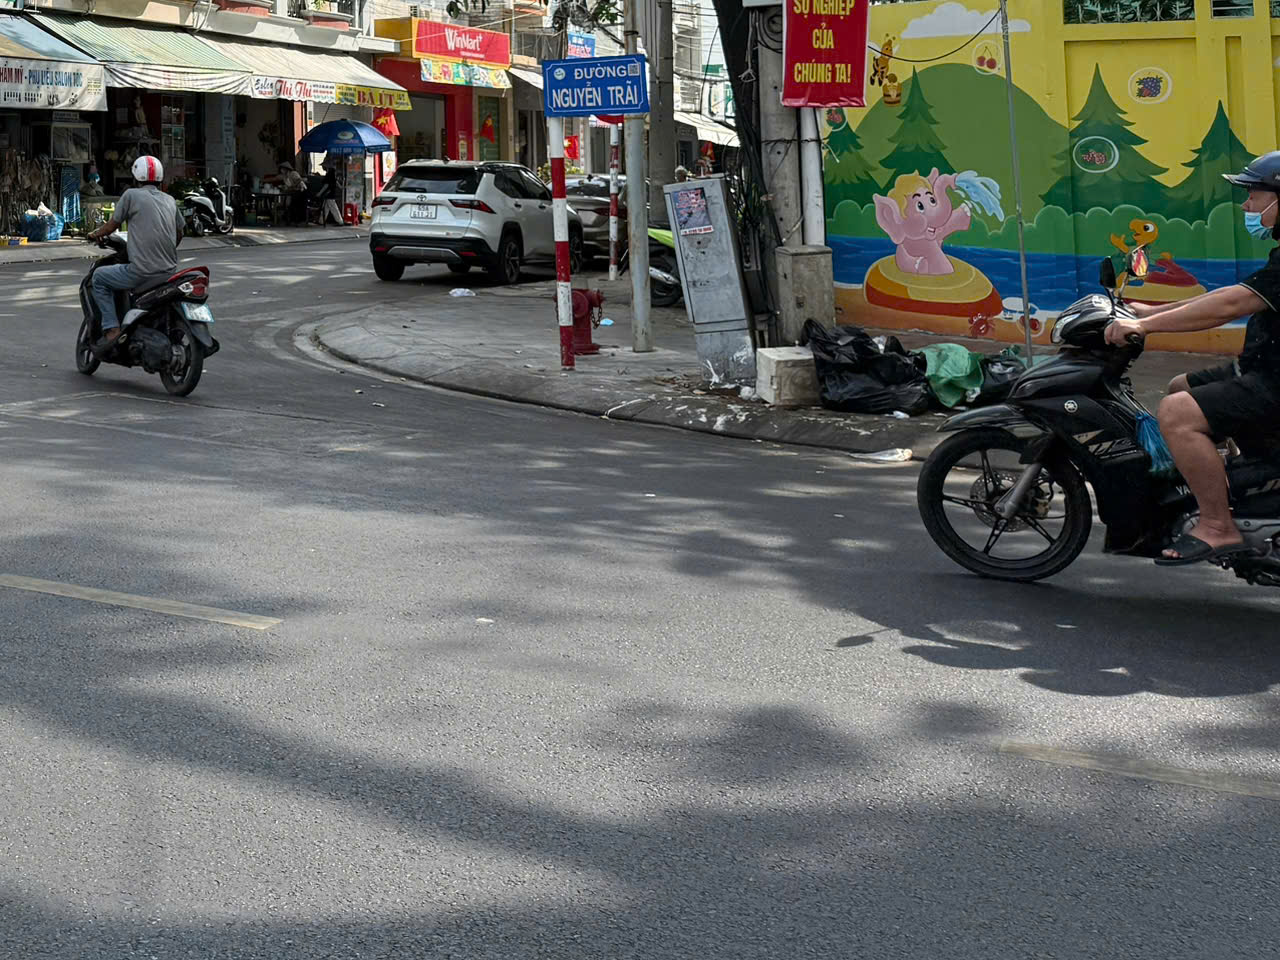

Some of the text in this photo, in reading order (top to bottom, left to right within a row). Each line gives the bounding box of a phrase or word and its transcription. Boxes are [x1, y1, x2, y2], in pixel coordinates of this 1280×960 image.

[814, 23, 835, 50] CỦA
[55, 70, 72, 87] SALON
[574, 63, 627, 81] ĐƯỜNG
[795, 60, 852, 83] CHÚNG TA!
[552, 80, 639, 108] NGUYỄN TRÃI
